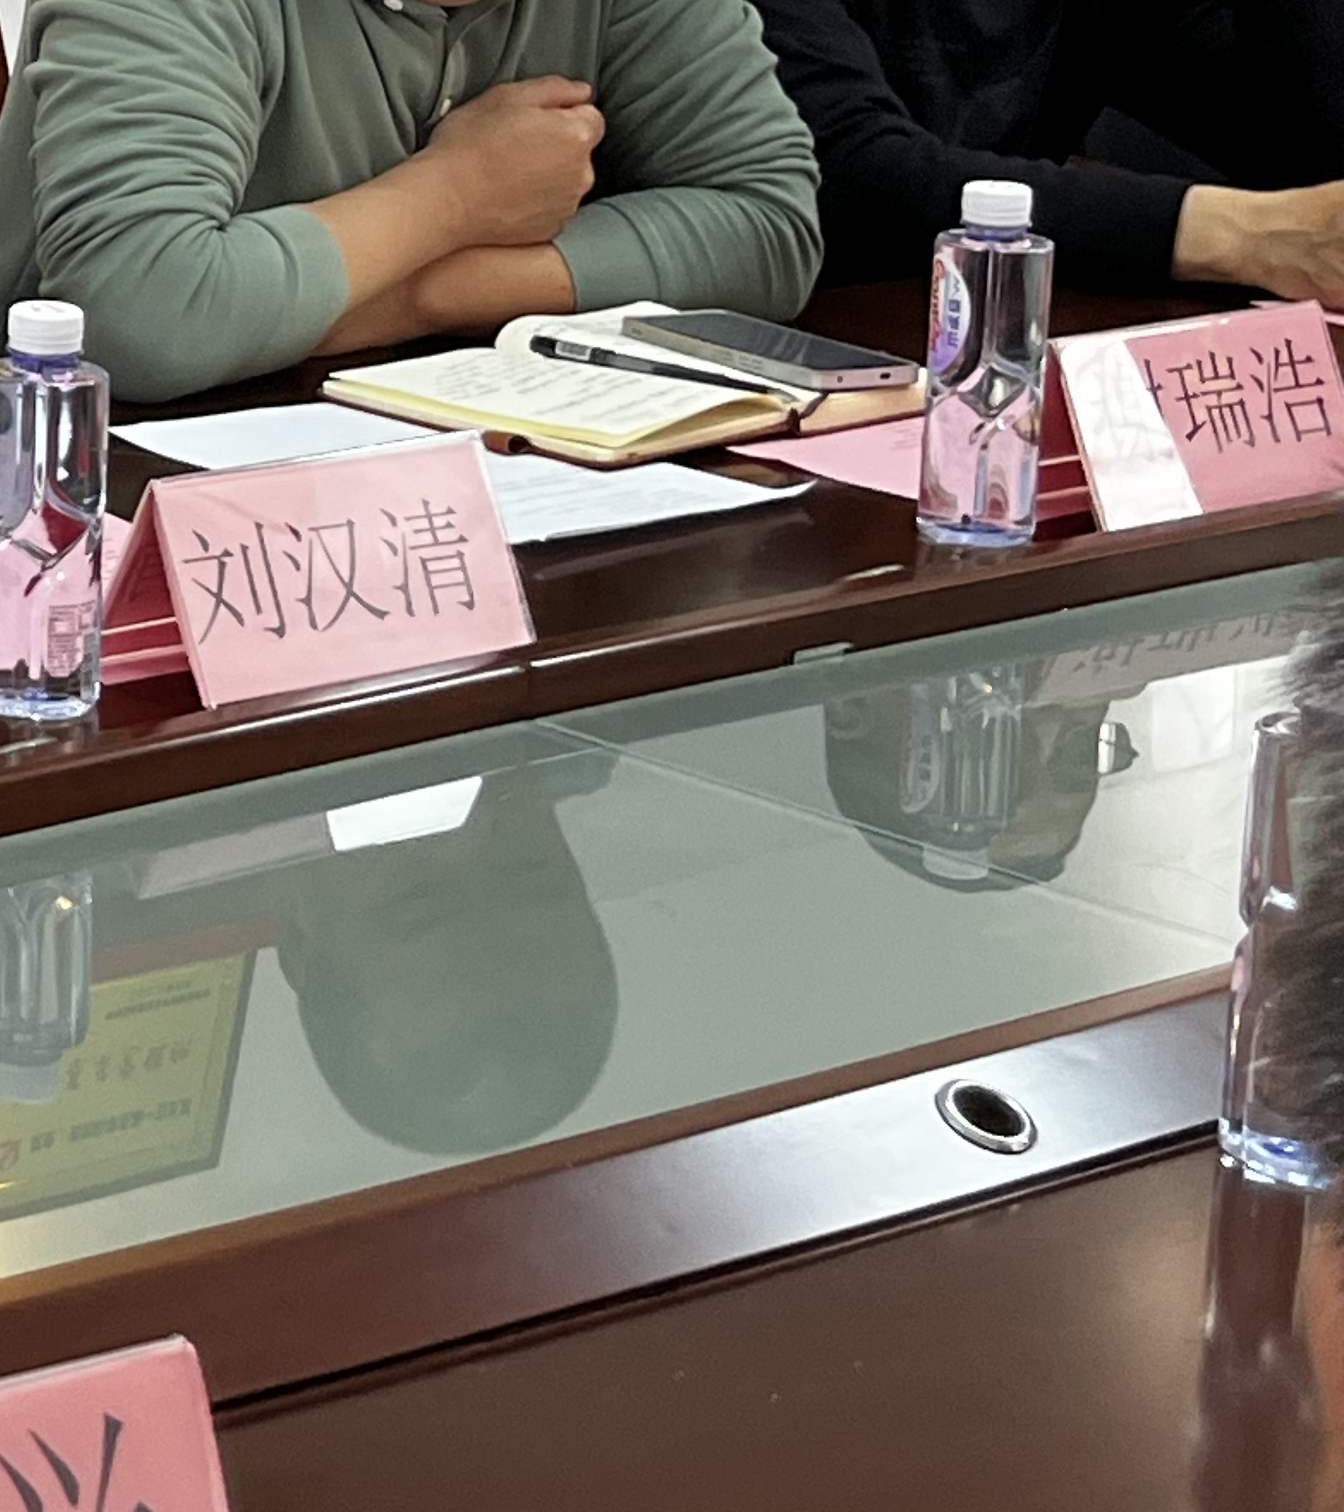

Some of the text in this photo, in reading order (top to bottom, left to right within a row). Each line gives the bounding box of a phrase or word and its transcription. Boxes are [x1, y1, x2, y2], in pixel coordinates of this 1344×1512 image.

[1143, 337, 1335, 455] 瑞浩
[182, 498, 478, 645] 刘汉清
